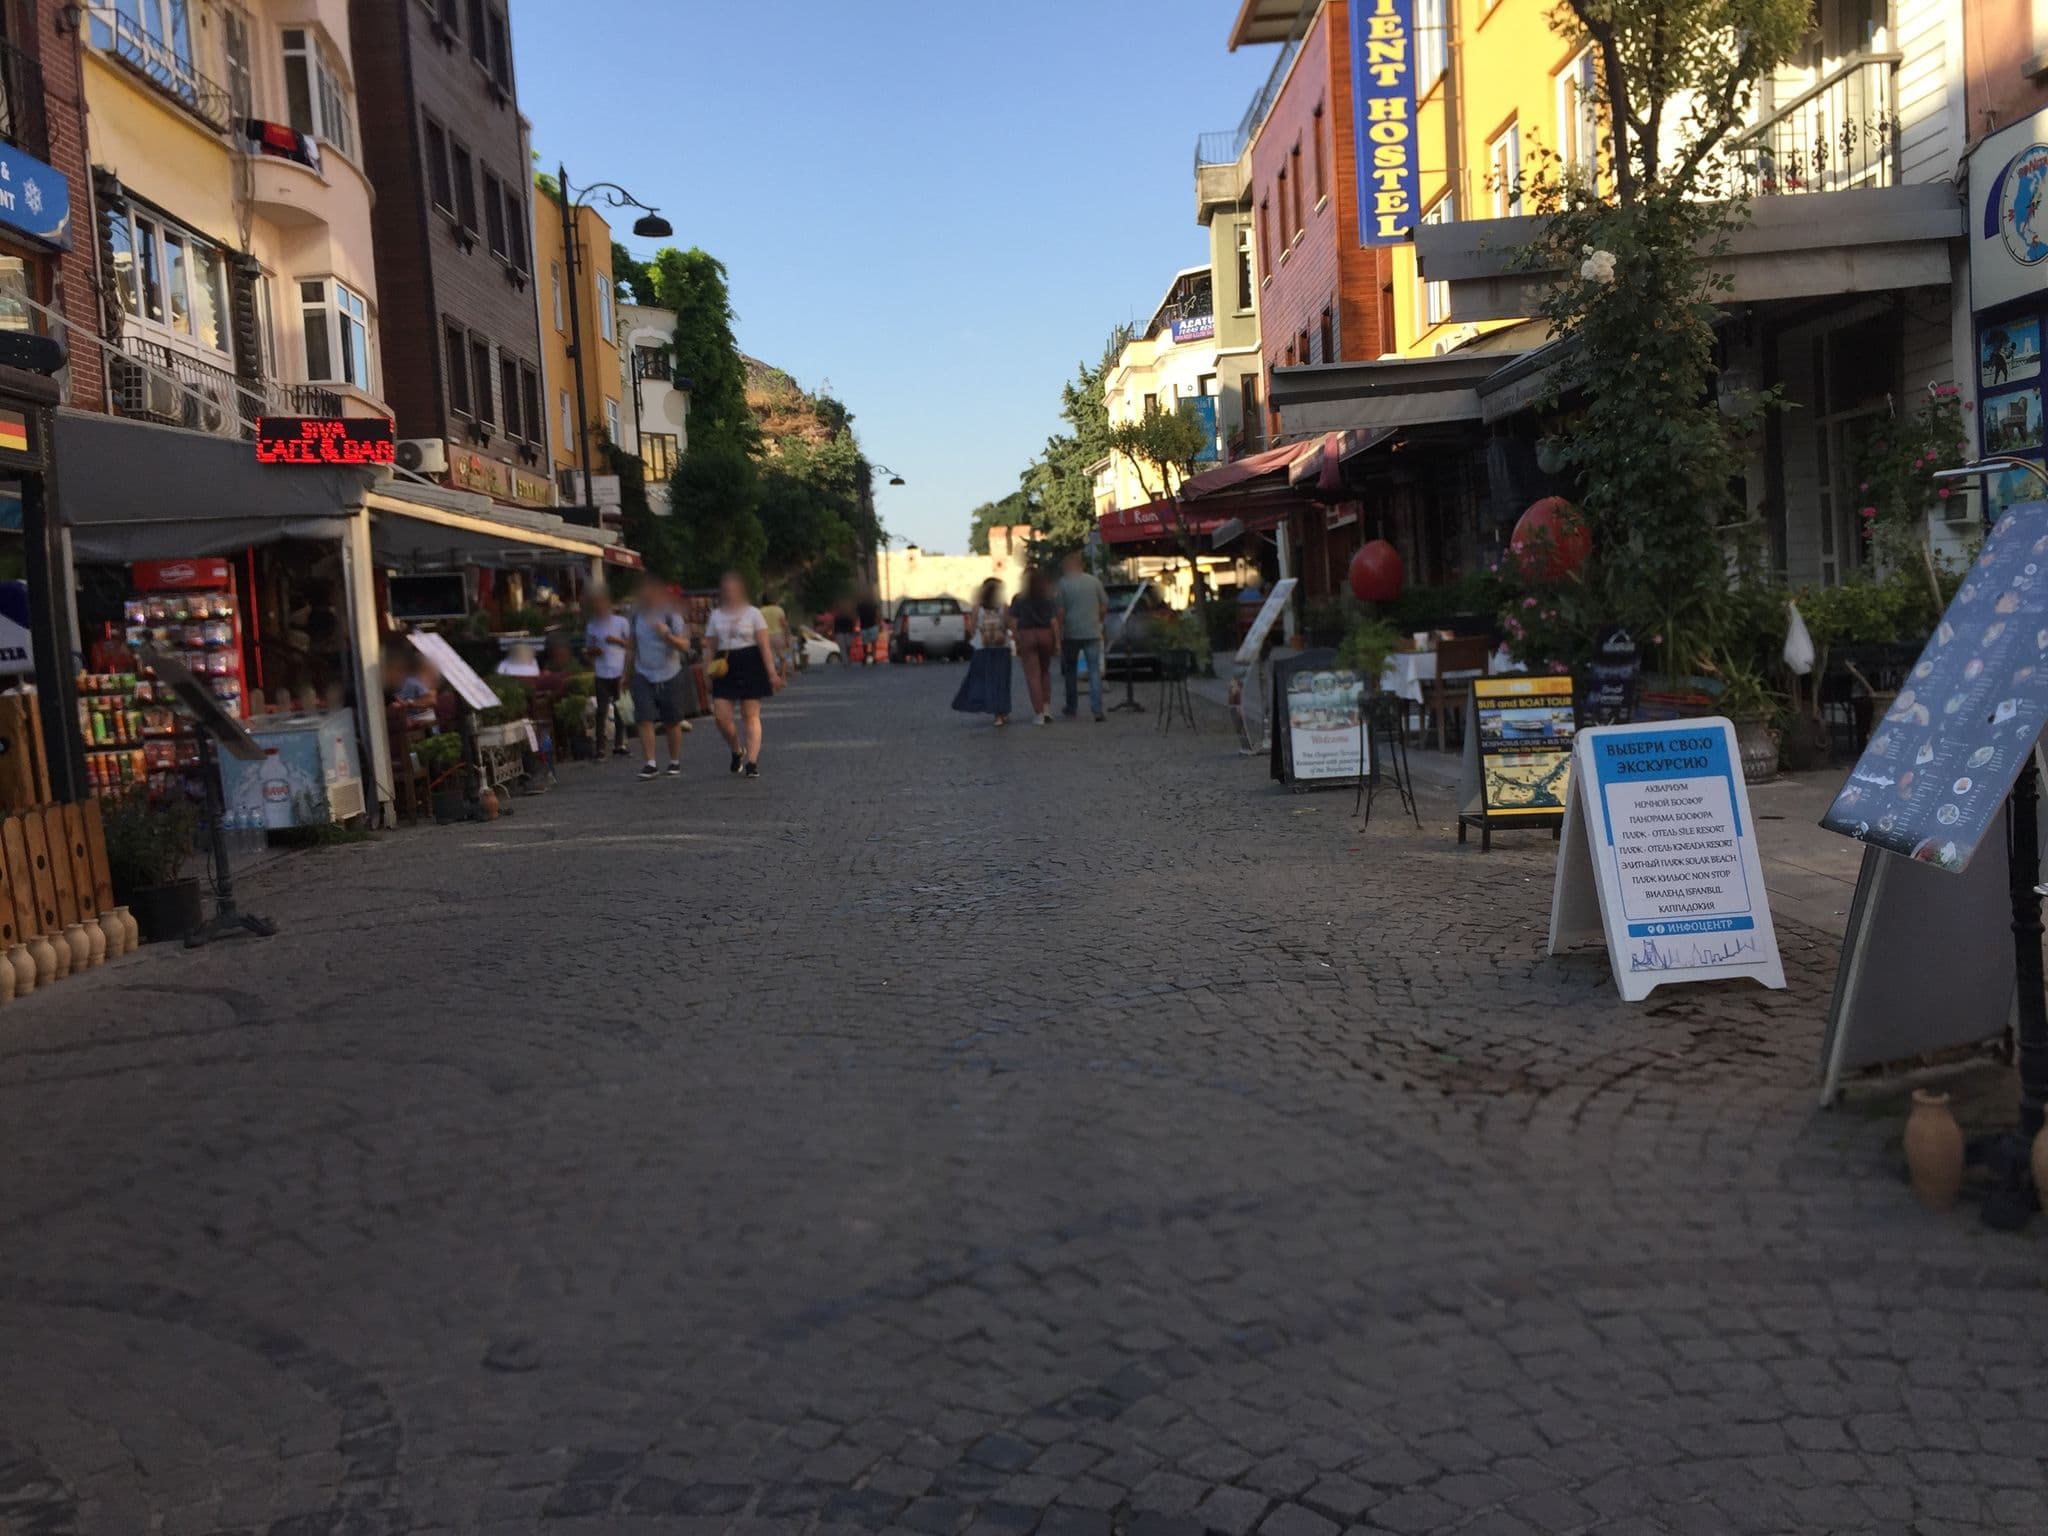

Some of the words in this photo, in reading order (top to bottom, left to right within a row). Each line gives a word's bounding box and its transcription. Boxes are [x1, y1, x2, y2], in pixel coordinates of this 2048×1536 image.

[1367, 97, 1410, 237] HOSTEL
[320, 438, 340, 460] &
[1606, 740, 1664, 757] ВЫБЕРИ
[1669, 736, 1712, 751] СВОЮ
[1617, 756, 1708, 774] ЭКСКУРСИЮ
[1644, 783, 1688, 793] АКВАРИУМ
[1634, 799, 1669, 809] НОЧНОЙ
[1671, 797, 1703, 807] БОСФОР
[1629, 815, 1674, 824] ПАНОРАМА
[1676, 812, 1713, 822] БОСФОРА
[1622, 831, 1647, 840] ПЛЯЖ
[1652, 828, 1678, 838] ОТЕЛЬ
[1696, 825, 1725, 834] RESORT
[1619, 847, 1643, 855] ПЛЯЖ
[1647, 844, 1673, 853] ОТЕЛЬ
[1706, 840, 1733, 849] RESORT
[1621, 859, 1661, 870] ЭЛИТНЫЙ
[1661, 860, 1685, 868] ПЛЯЖ
[1685, 857, 1710, 866] SOLAR
[1711, 854, 1737, 864] BEACH
[1632, 876, 1657, 885] ПЛЯЖ
[1658, 873, 1690, 883] КИЛЬОС
[1691, 872, 1710, 881] NON
[1711, 870, 1731, 879] STOP
[1645, 889, 1684, 900] ВИАЛЕНД
[1658, 902, 1715, 914] КАППАДОКИЯ
[1667, 919, 1733, 933] ИНФОЦЕНТР
